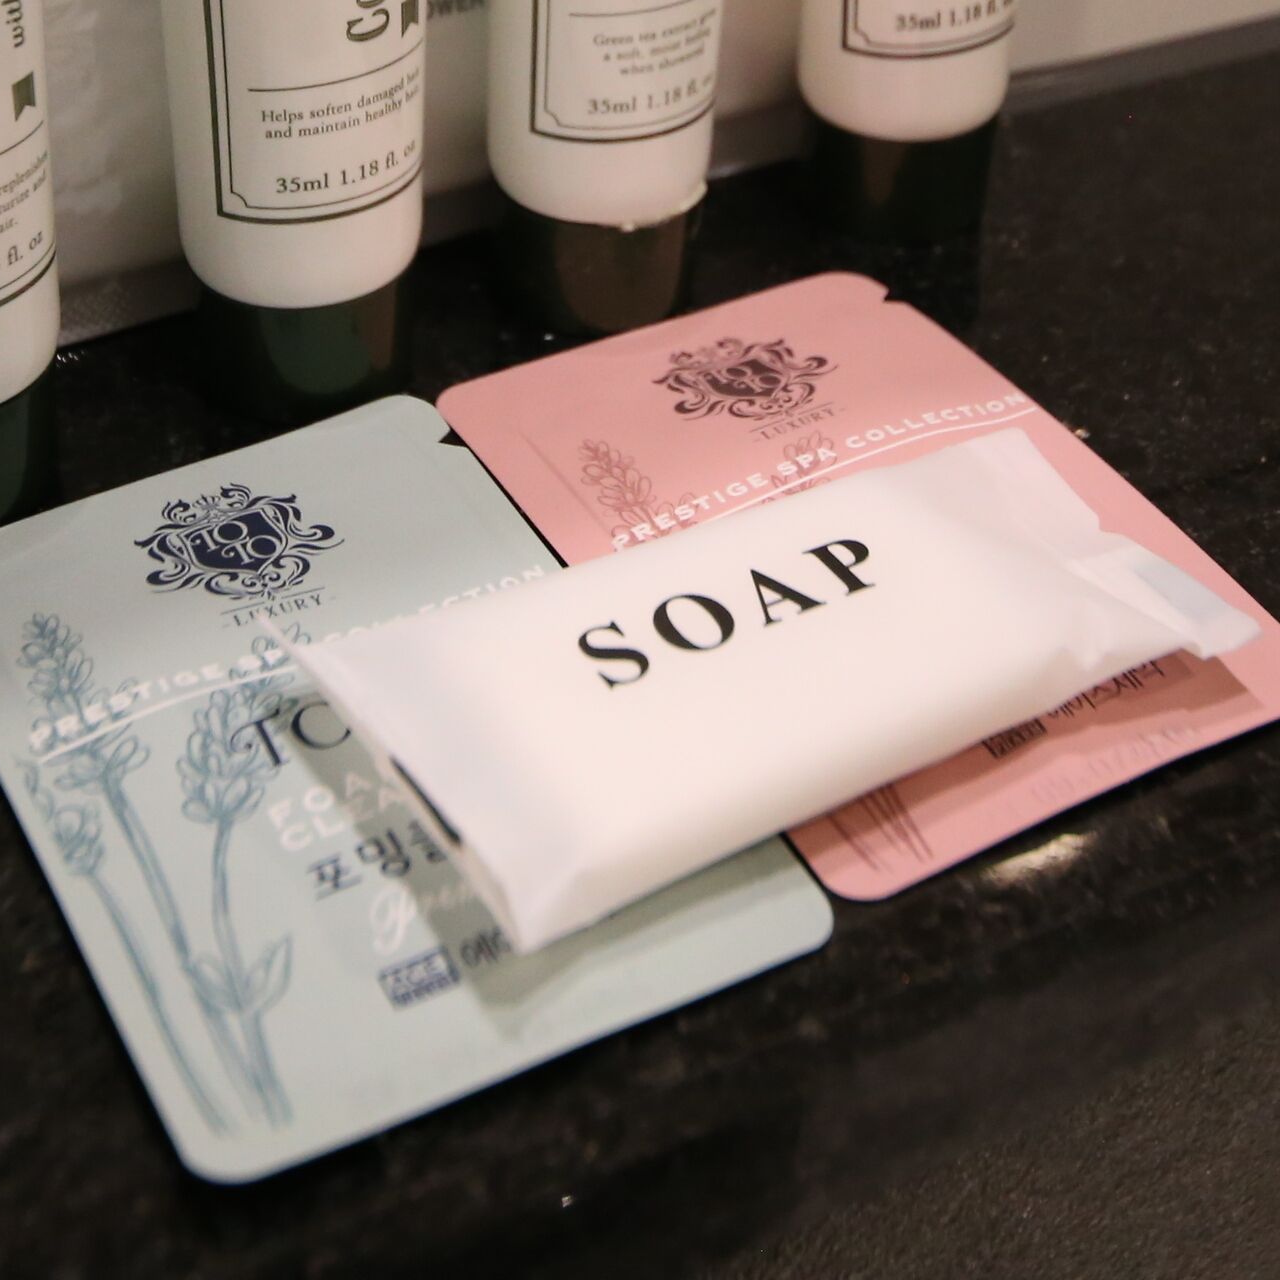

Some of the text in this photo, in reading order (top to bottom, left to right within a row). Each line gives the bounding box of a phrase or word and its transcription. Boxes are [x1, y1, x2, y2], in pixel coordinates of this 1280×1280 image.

[896, 11, 941, 31] 35ml
[261, 109, 304, 125] Helps
[309, 102, 352, 120] soften
[357, 77, 404, 109] damaged
[265, 125, 293, 139] and
[298, 117, 361, 138] maintain
[365, 98, 403, 123] healthy
[587, 96, 637, 115] 35ml
[276, 172, 330, 194] 35ml
[340, 159, 380, 186] 1.18
[385, 150, 399, 169] fl.
[7, 245, 24, 267] fl.
[28, 230, 44, 251] oz
[759, 407, 836, 440] LUXURY
[611, 393, 1029, 551] PRESTIGE SPA COLLECTION
[577, 537, 877, 690] SOAP
[30, 663, 223, 753] PRESTIGE
[237, 647, 287, 672] SP
